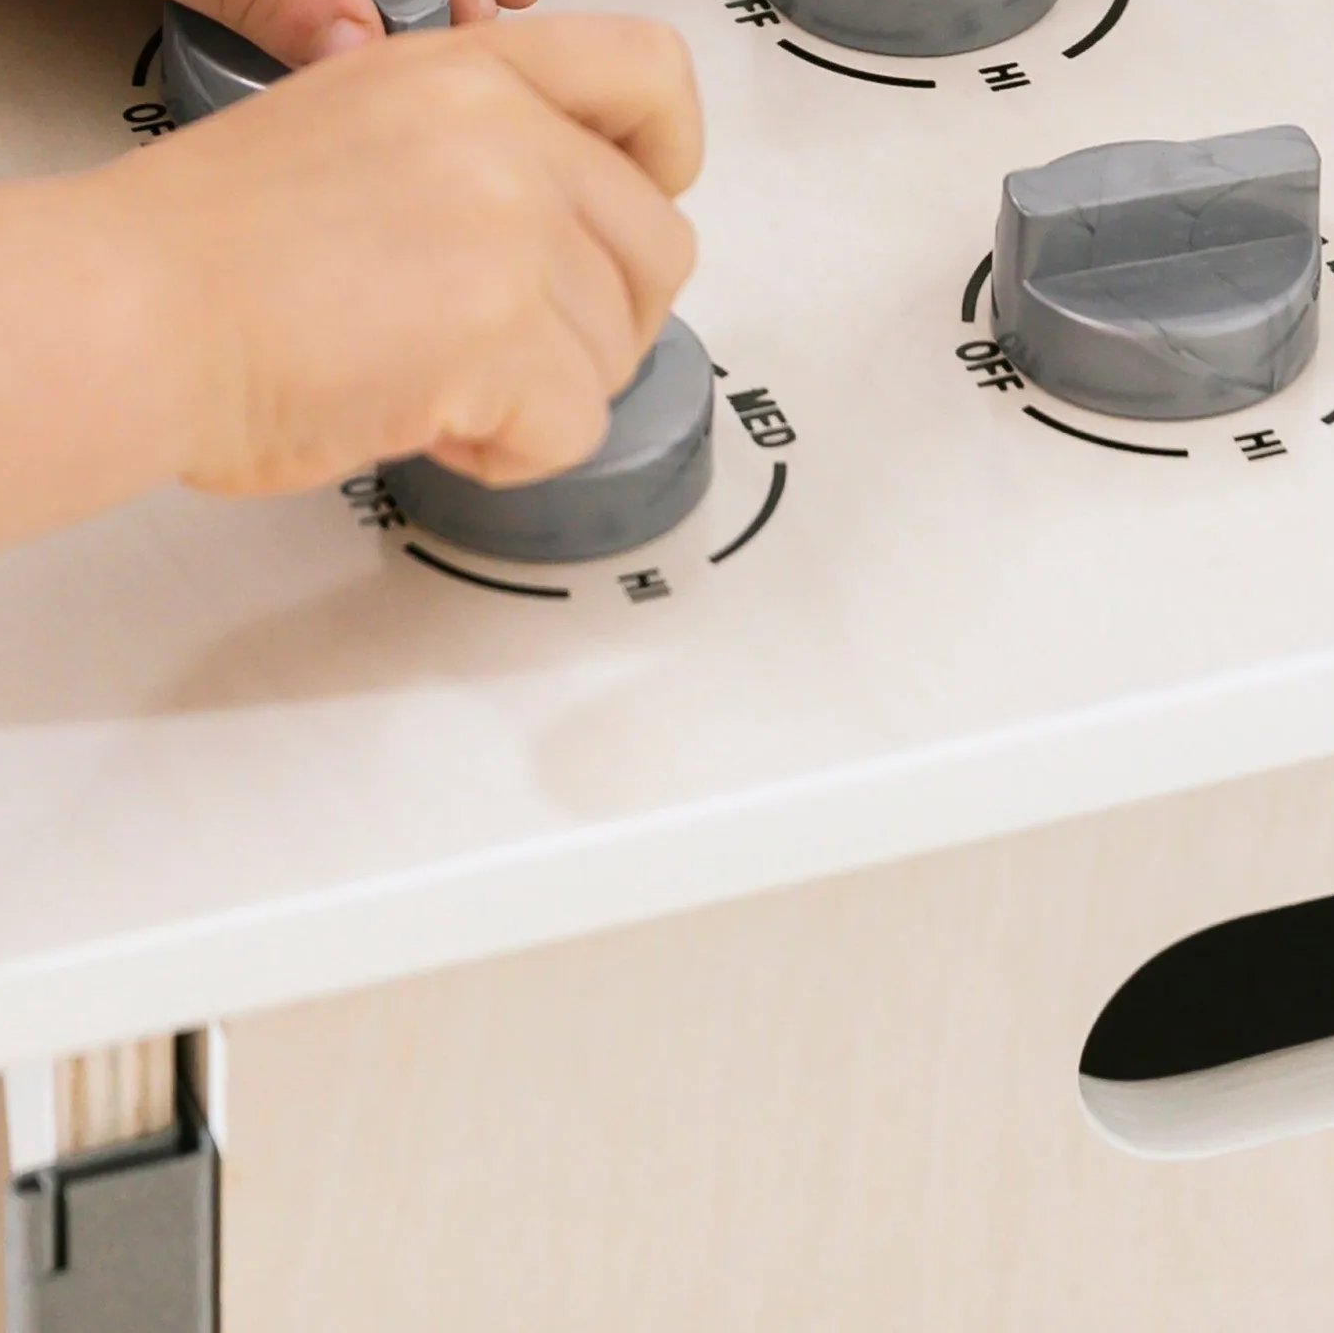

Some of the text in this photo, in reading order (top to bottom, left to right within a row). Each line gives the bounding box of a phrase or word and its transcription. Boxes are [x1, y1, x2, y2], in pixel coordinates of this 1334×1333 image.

[978, 62, 1032, 92] HI
[123, 103, 176, 147] OF
[955, 340, 1025, 392] OFF
[726, 387, 797, 448] MED
[1233, 429, 1288, 461] HI
[340, 475, 407, 529] OFF
[617, 567, 672, 603] HI
